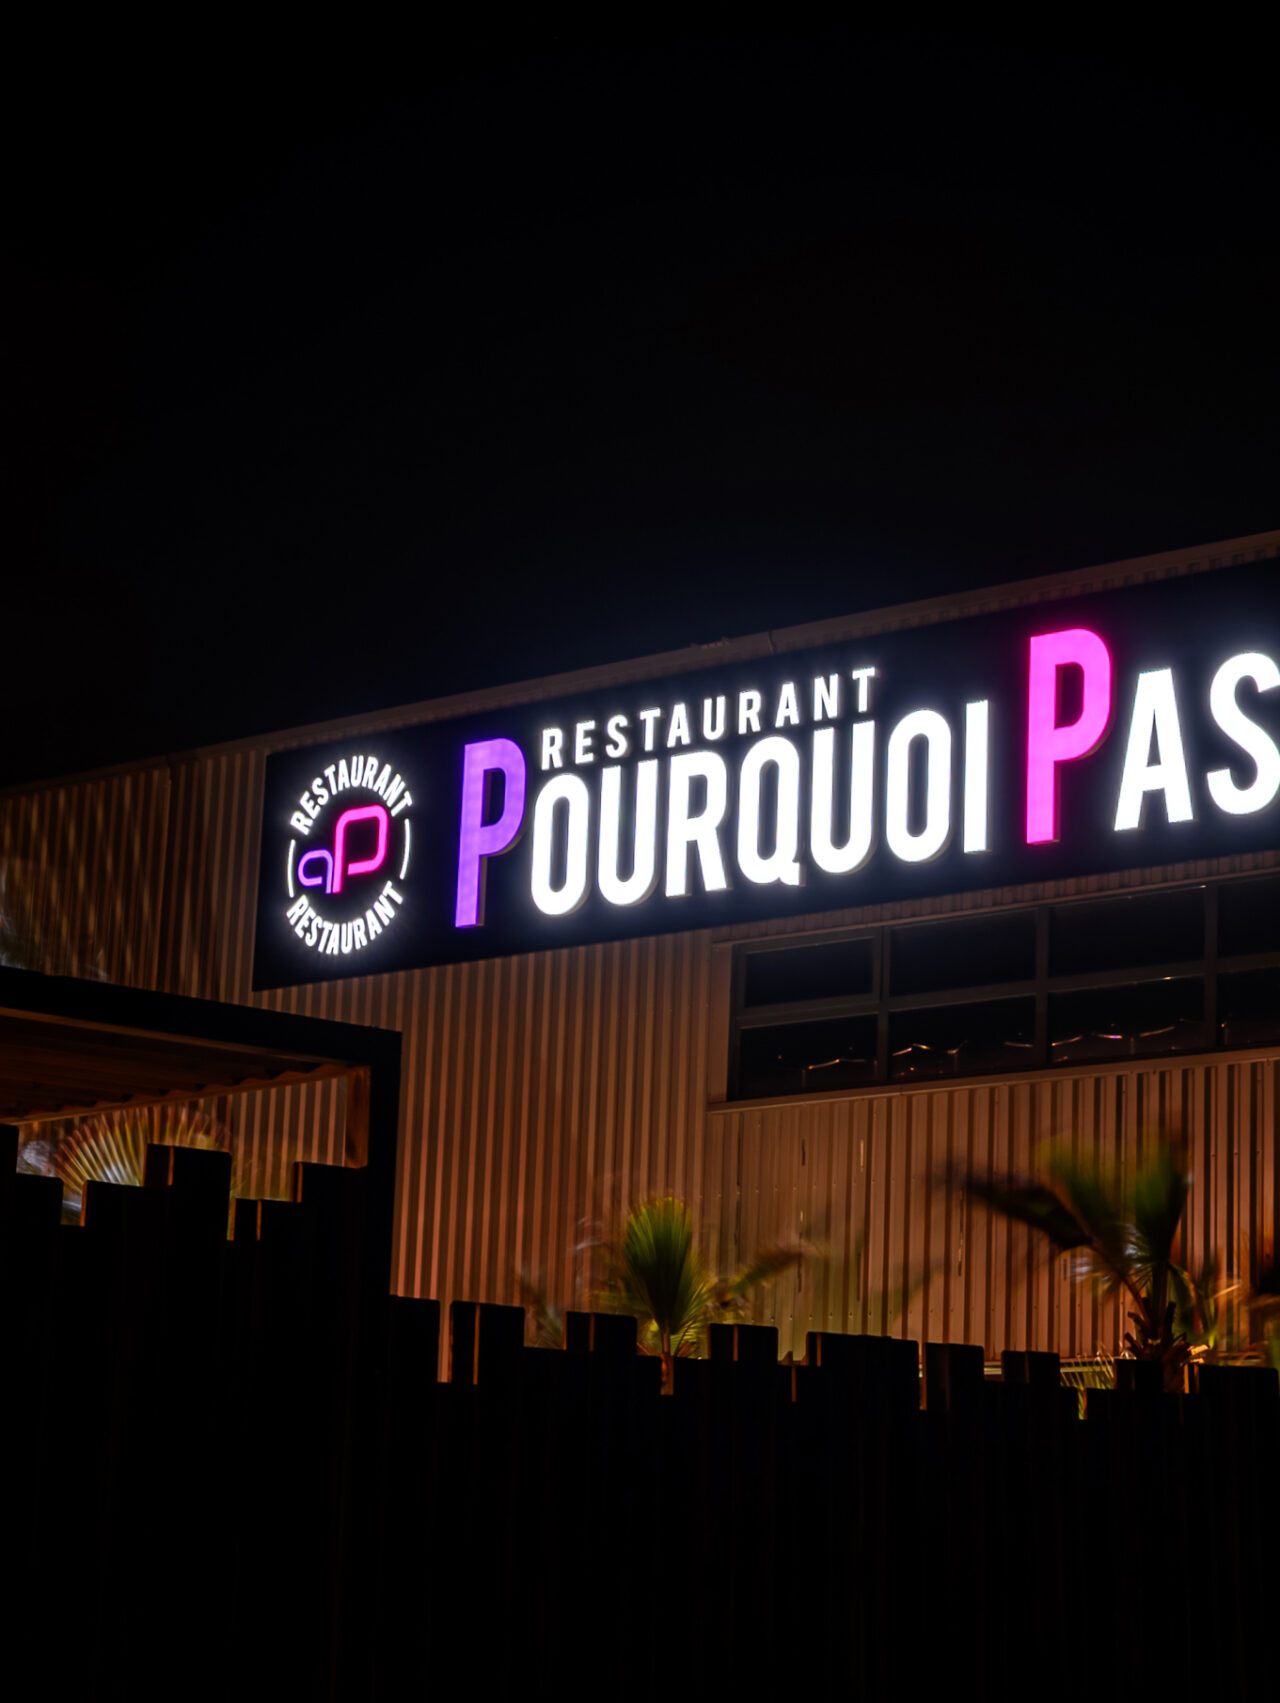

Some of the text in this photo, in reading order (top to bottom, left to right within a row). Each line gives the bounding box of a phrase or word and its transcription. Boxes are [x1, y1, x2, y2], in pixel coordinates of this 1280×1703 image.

[541, 666, 876, 771] RESTAURANT
[289, 754, 413, 836] RESTAURANT
[455, 700, 989, 928] POURQUOI
[286, 880, 404, 956] RESTAURANT
